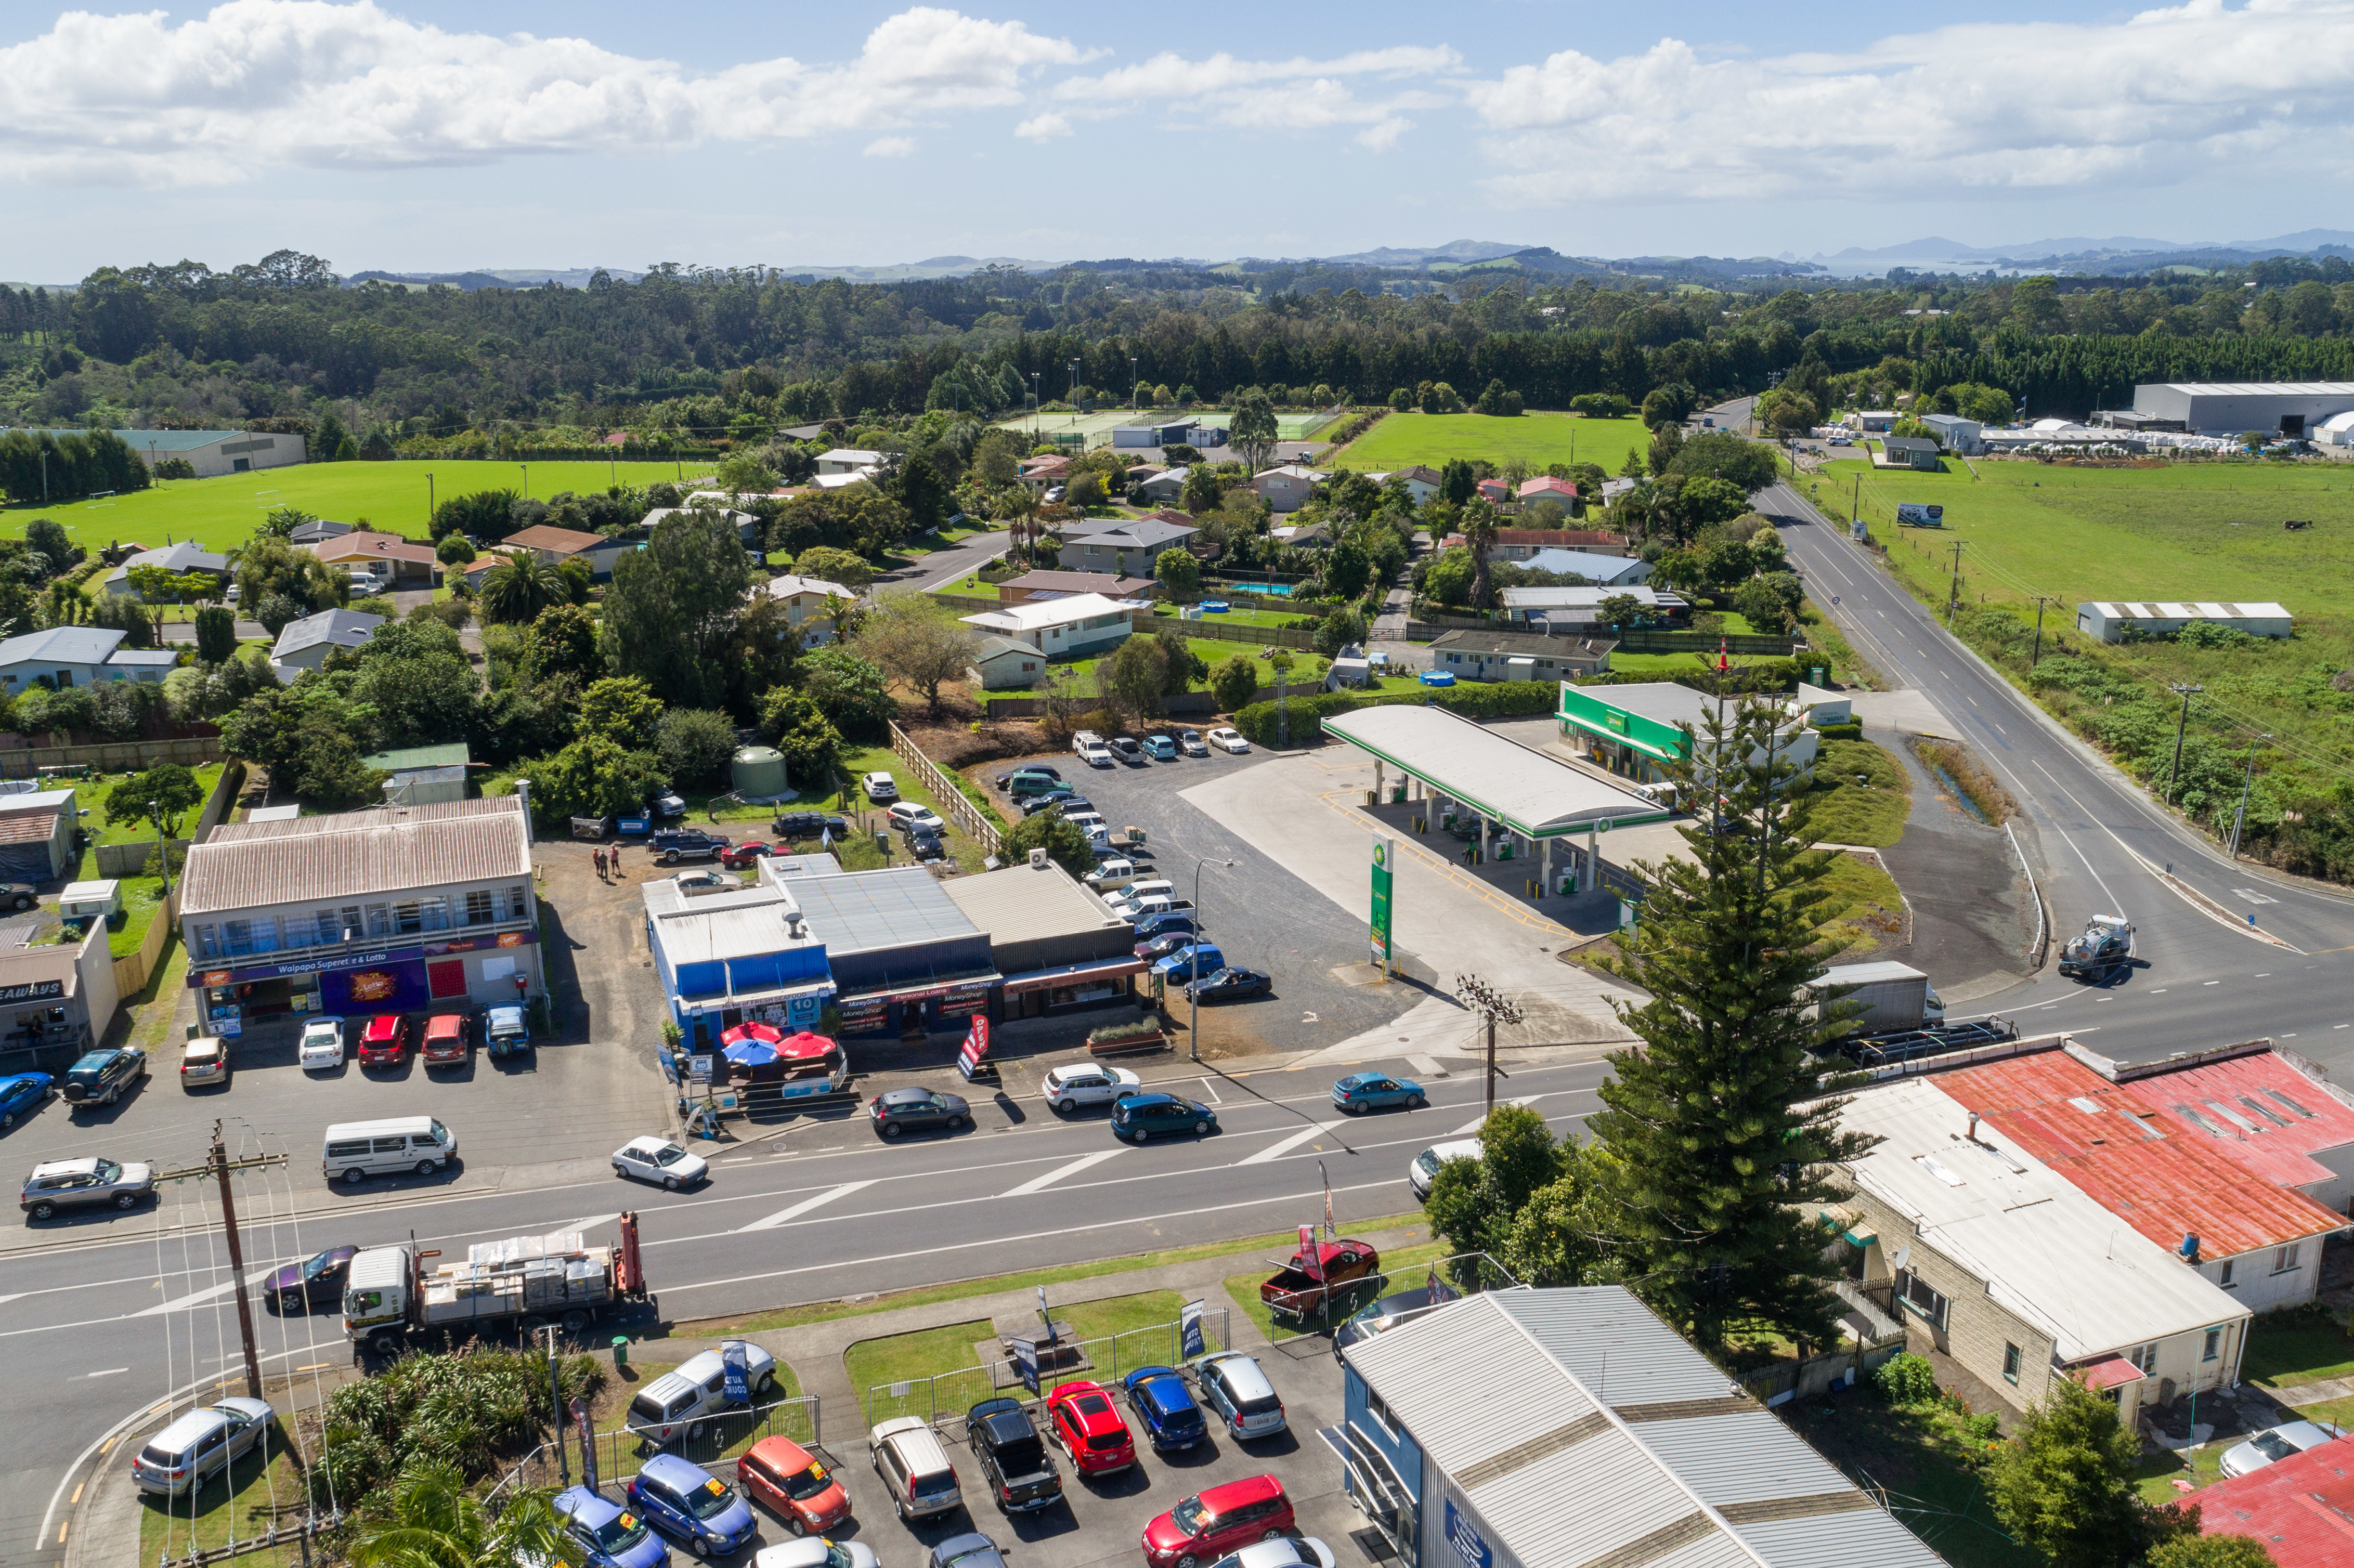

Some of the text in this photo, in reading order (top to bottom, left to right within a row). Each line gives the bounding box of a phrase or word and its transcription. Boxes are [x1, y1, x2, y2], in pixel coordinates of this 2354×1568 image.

[279, 963, 316, 973] Waipapa
[317, 958, 357, 969] Superete
[366, 953, 386, 962] Lotto
[362, 981, 384, 990] Lotto
[961, 981, 993, 990] MoneyShop
[775, 992, 807, 1003] SEAFOOD
[895, 988, 947, 1000] Personal Loans
[944, 991, 982, 1002] MoneyShop
[795, 999, 812, 1009] 10
[849, 998, 881, 1007] MoneyShop
[842, 1008, 881, 1017] MoneyShop
[976, 1019, 986, 1050] OPEN
[1187, 1328, 1198, 1342] AUTO
[1185, 1336, 1201, 1352] COURT
[1457, 1513, 1477, 1543] Waipapa
[1454, 1535, 1461, 1547] Ph
